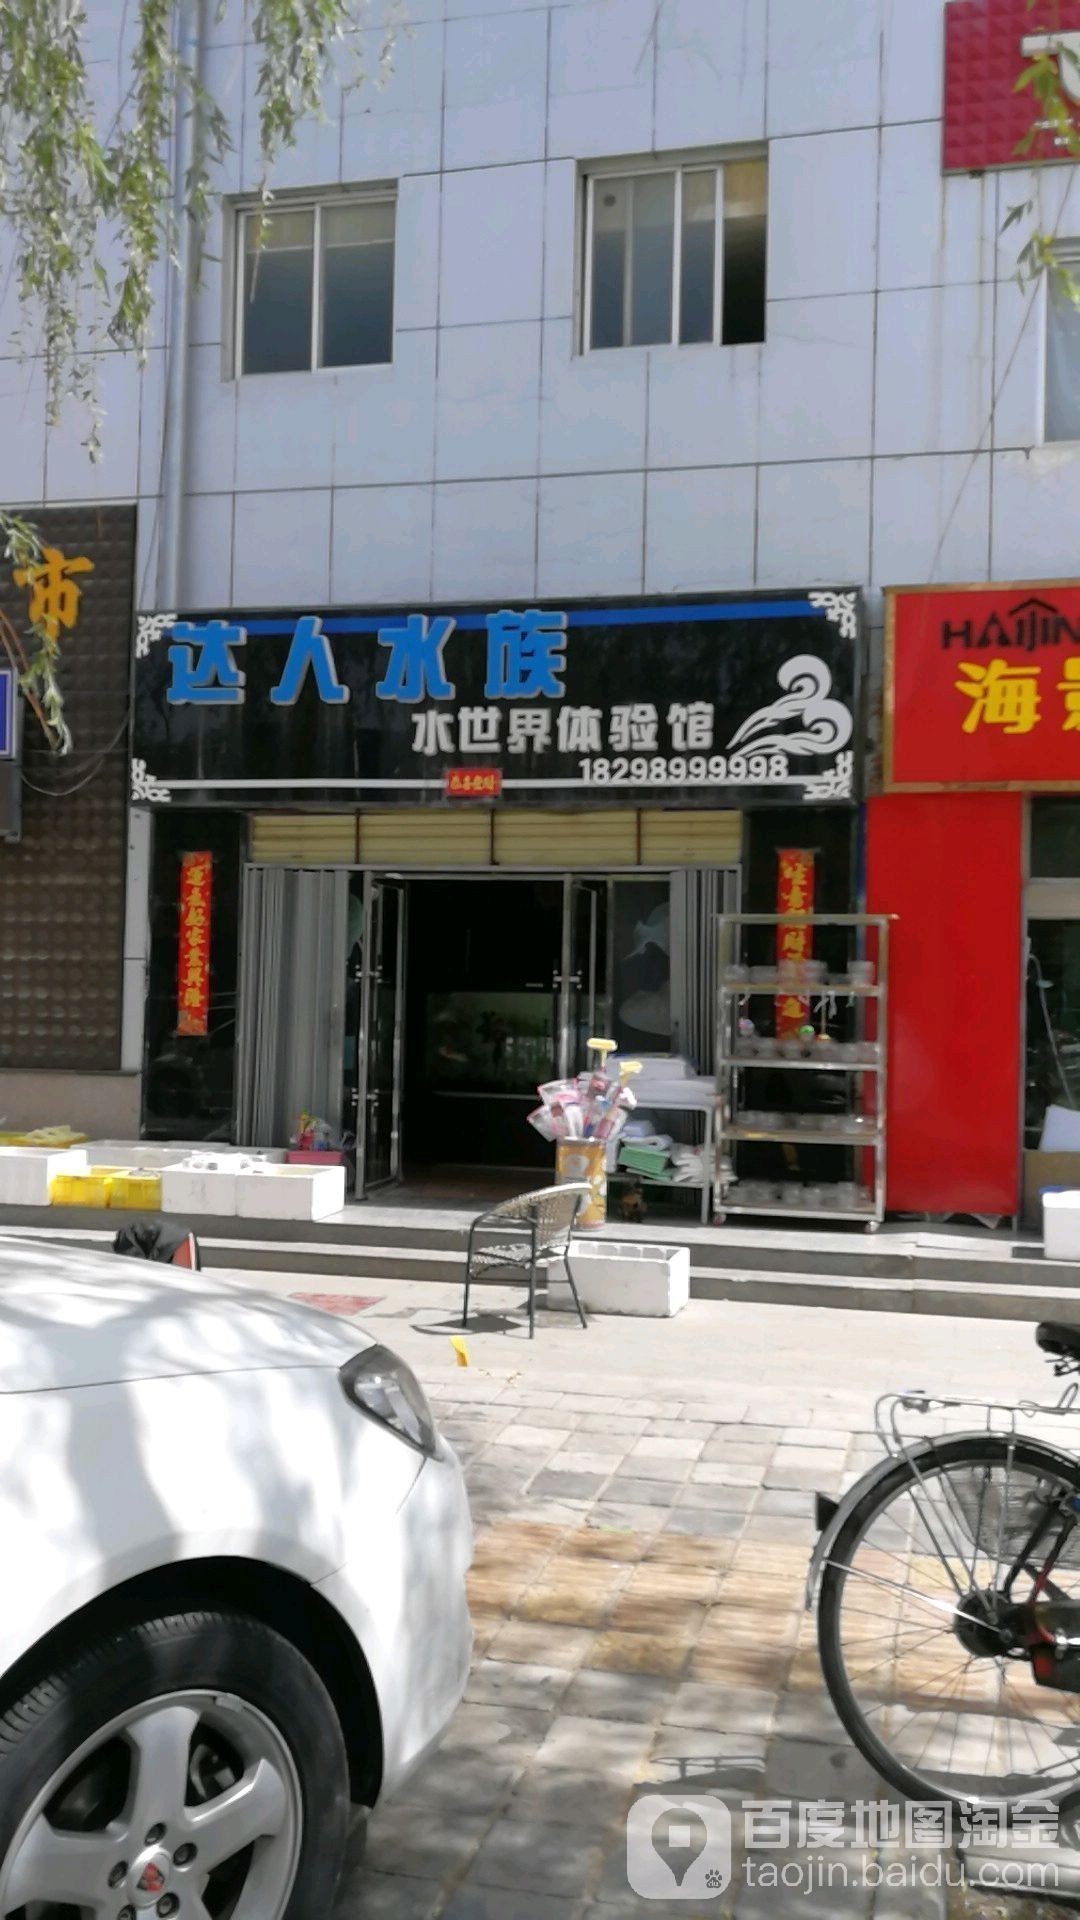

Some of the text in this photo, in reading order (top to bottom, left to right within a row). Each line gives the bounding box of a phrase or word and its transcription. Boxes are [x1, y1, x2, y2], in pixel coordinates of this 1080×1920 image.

[13, 548, 94, 640] 市
[167, 609, 569, 706] 达人水族
[954, 657, 1080, 734] 海
[411, 702, 716, 755] 水世界体验馆
[579, 754, 789, 786] 18298999998
